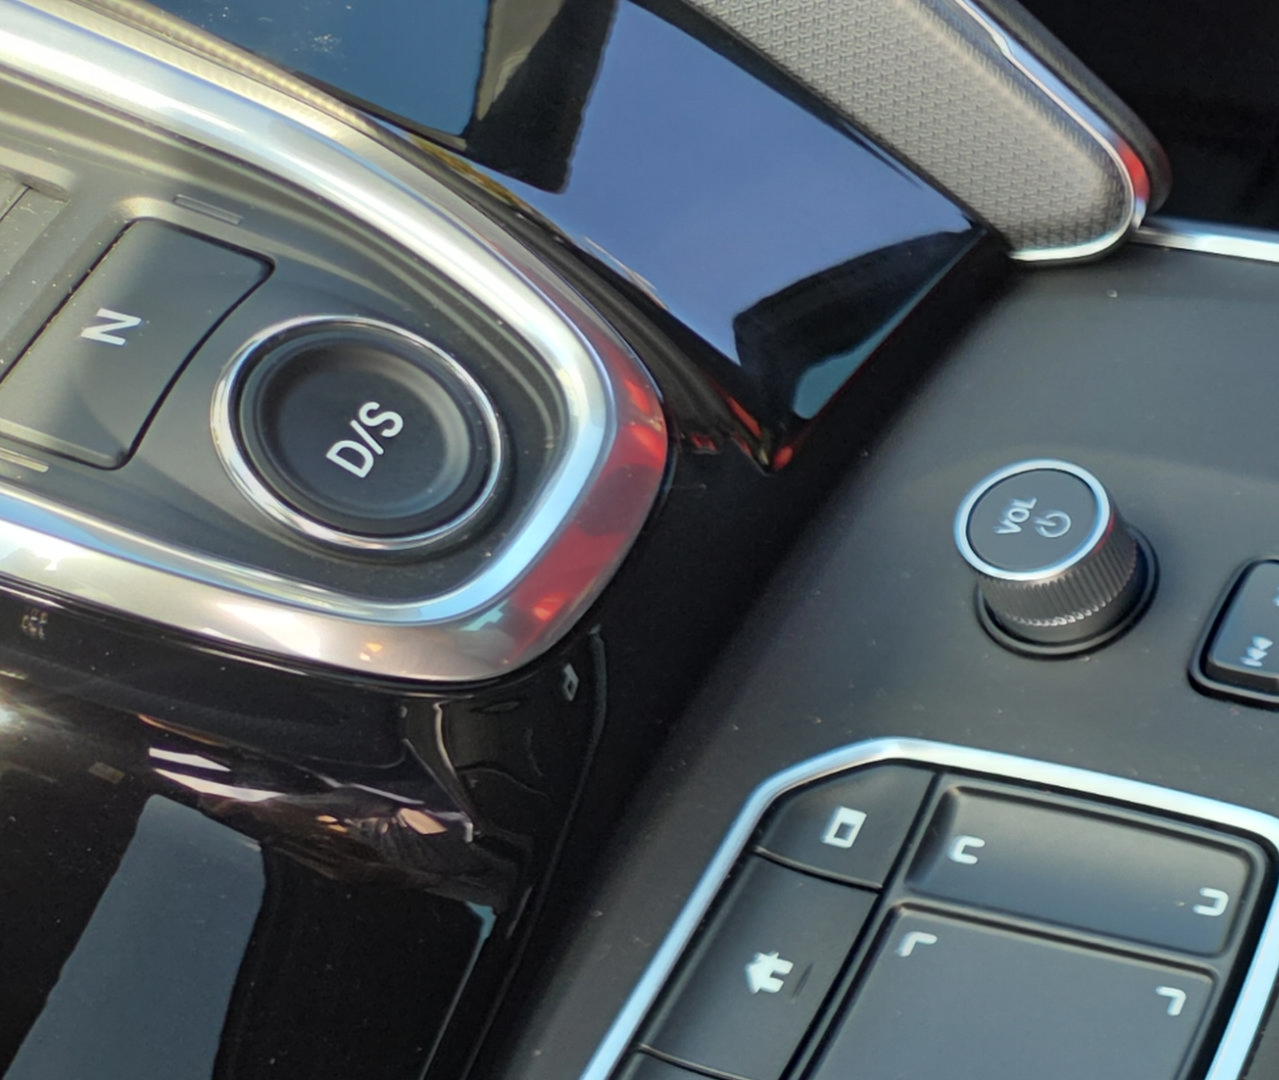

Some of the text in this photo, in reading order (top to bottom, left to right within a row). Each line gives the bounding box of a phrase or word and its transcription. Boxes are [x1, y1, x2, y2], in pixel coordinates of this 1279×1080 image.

[80, 308, 142, 346] N
[325, 401, 404, 479] D/S
[994, 497, 1037, 535] VOL
